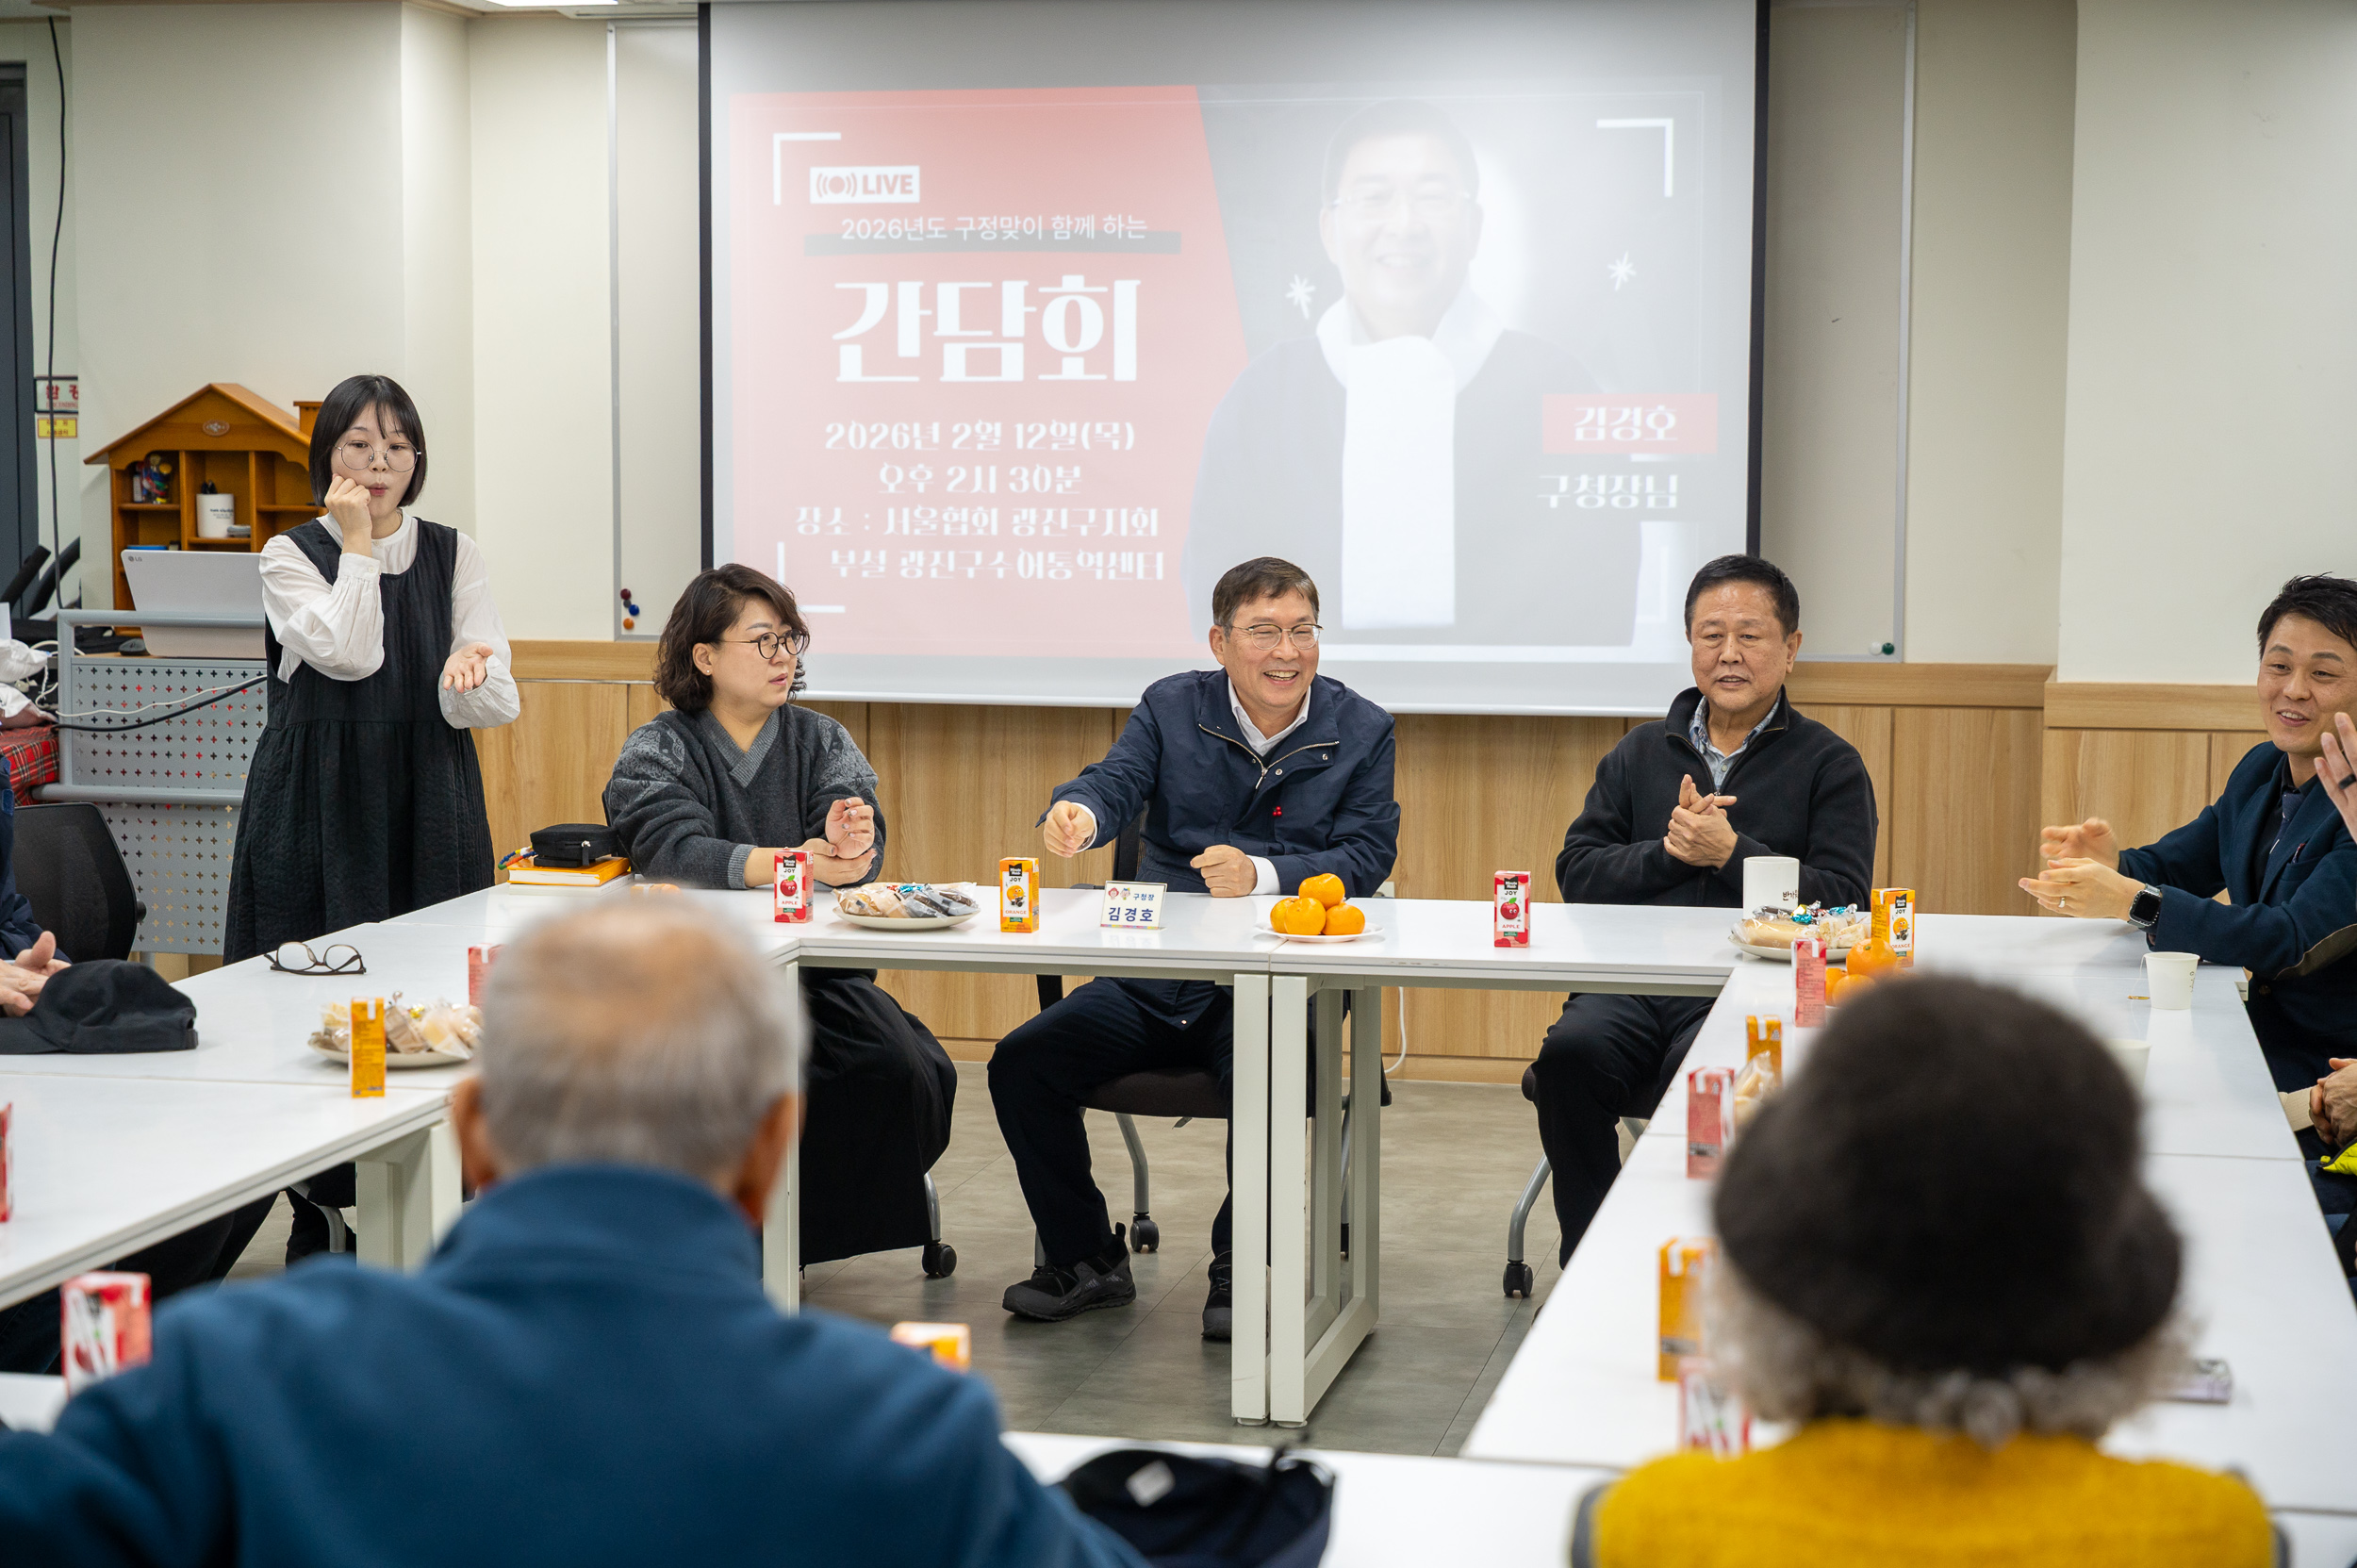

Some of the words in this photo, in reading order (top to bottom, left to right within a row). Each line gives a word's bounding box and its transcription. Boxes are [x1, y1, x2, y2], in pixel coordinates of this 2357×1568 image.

[862, 173, 914, 195] LIVE
[841, 217, 948, 241] 2026년도
[954, 215, 1043, 241] 구정맞이
[1051, 215, 1096, 239] 함께
[1102, 215, 1147, 239] 하는
[832, 275, 1142, 381] 간담회
[824, 420, 940, 451] 2026년
[951, 420, 1002, 451] 2월
[1014, 420, 1135, 451] 12일(목)
[1574, 404, 1678, 441] 김경호
[878, 462, 934, 494] 오후
[946, 464, 997, 494] 2시
[1009, 463, 1082, 494] 30분
[1537, 474, 1678, 509] 구청장님
[795, 505, 851, 536] 장소
[883, 503, 999, 536] 서울협회
[1011, 506, 1159, 536] 광진구지회
[831, 550, 887, 579] 부설
[899, 548, 1164, 580] 광진구수어통역센터
[1133, 893, 1155, 901] 구청장
[1108, 906, 1153, 922] 김경호
